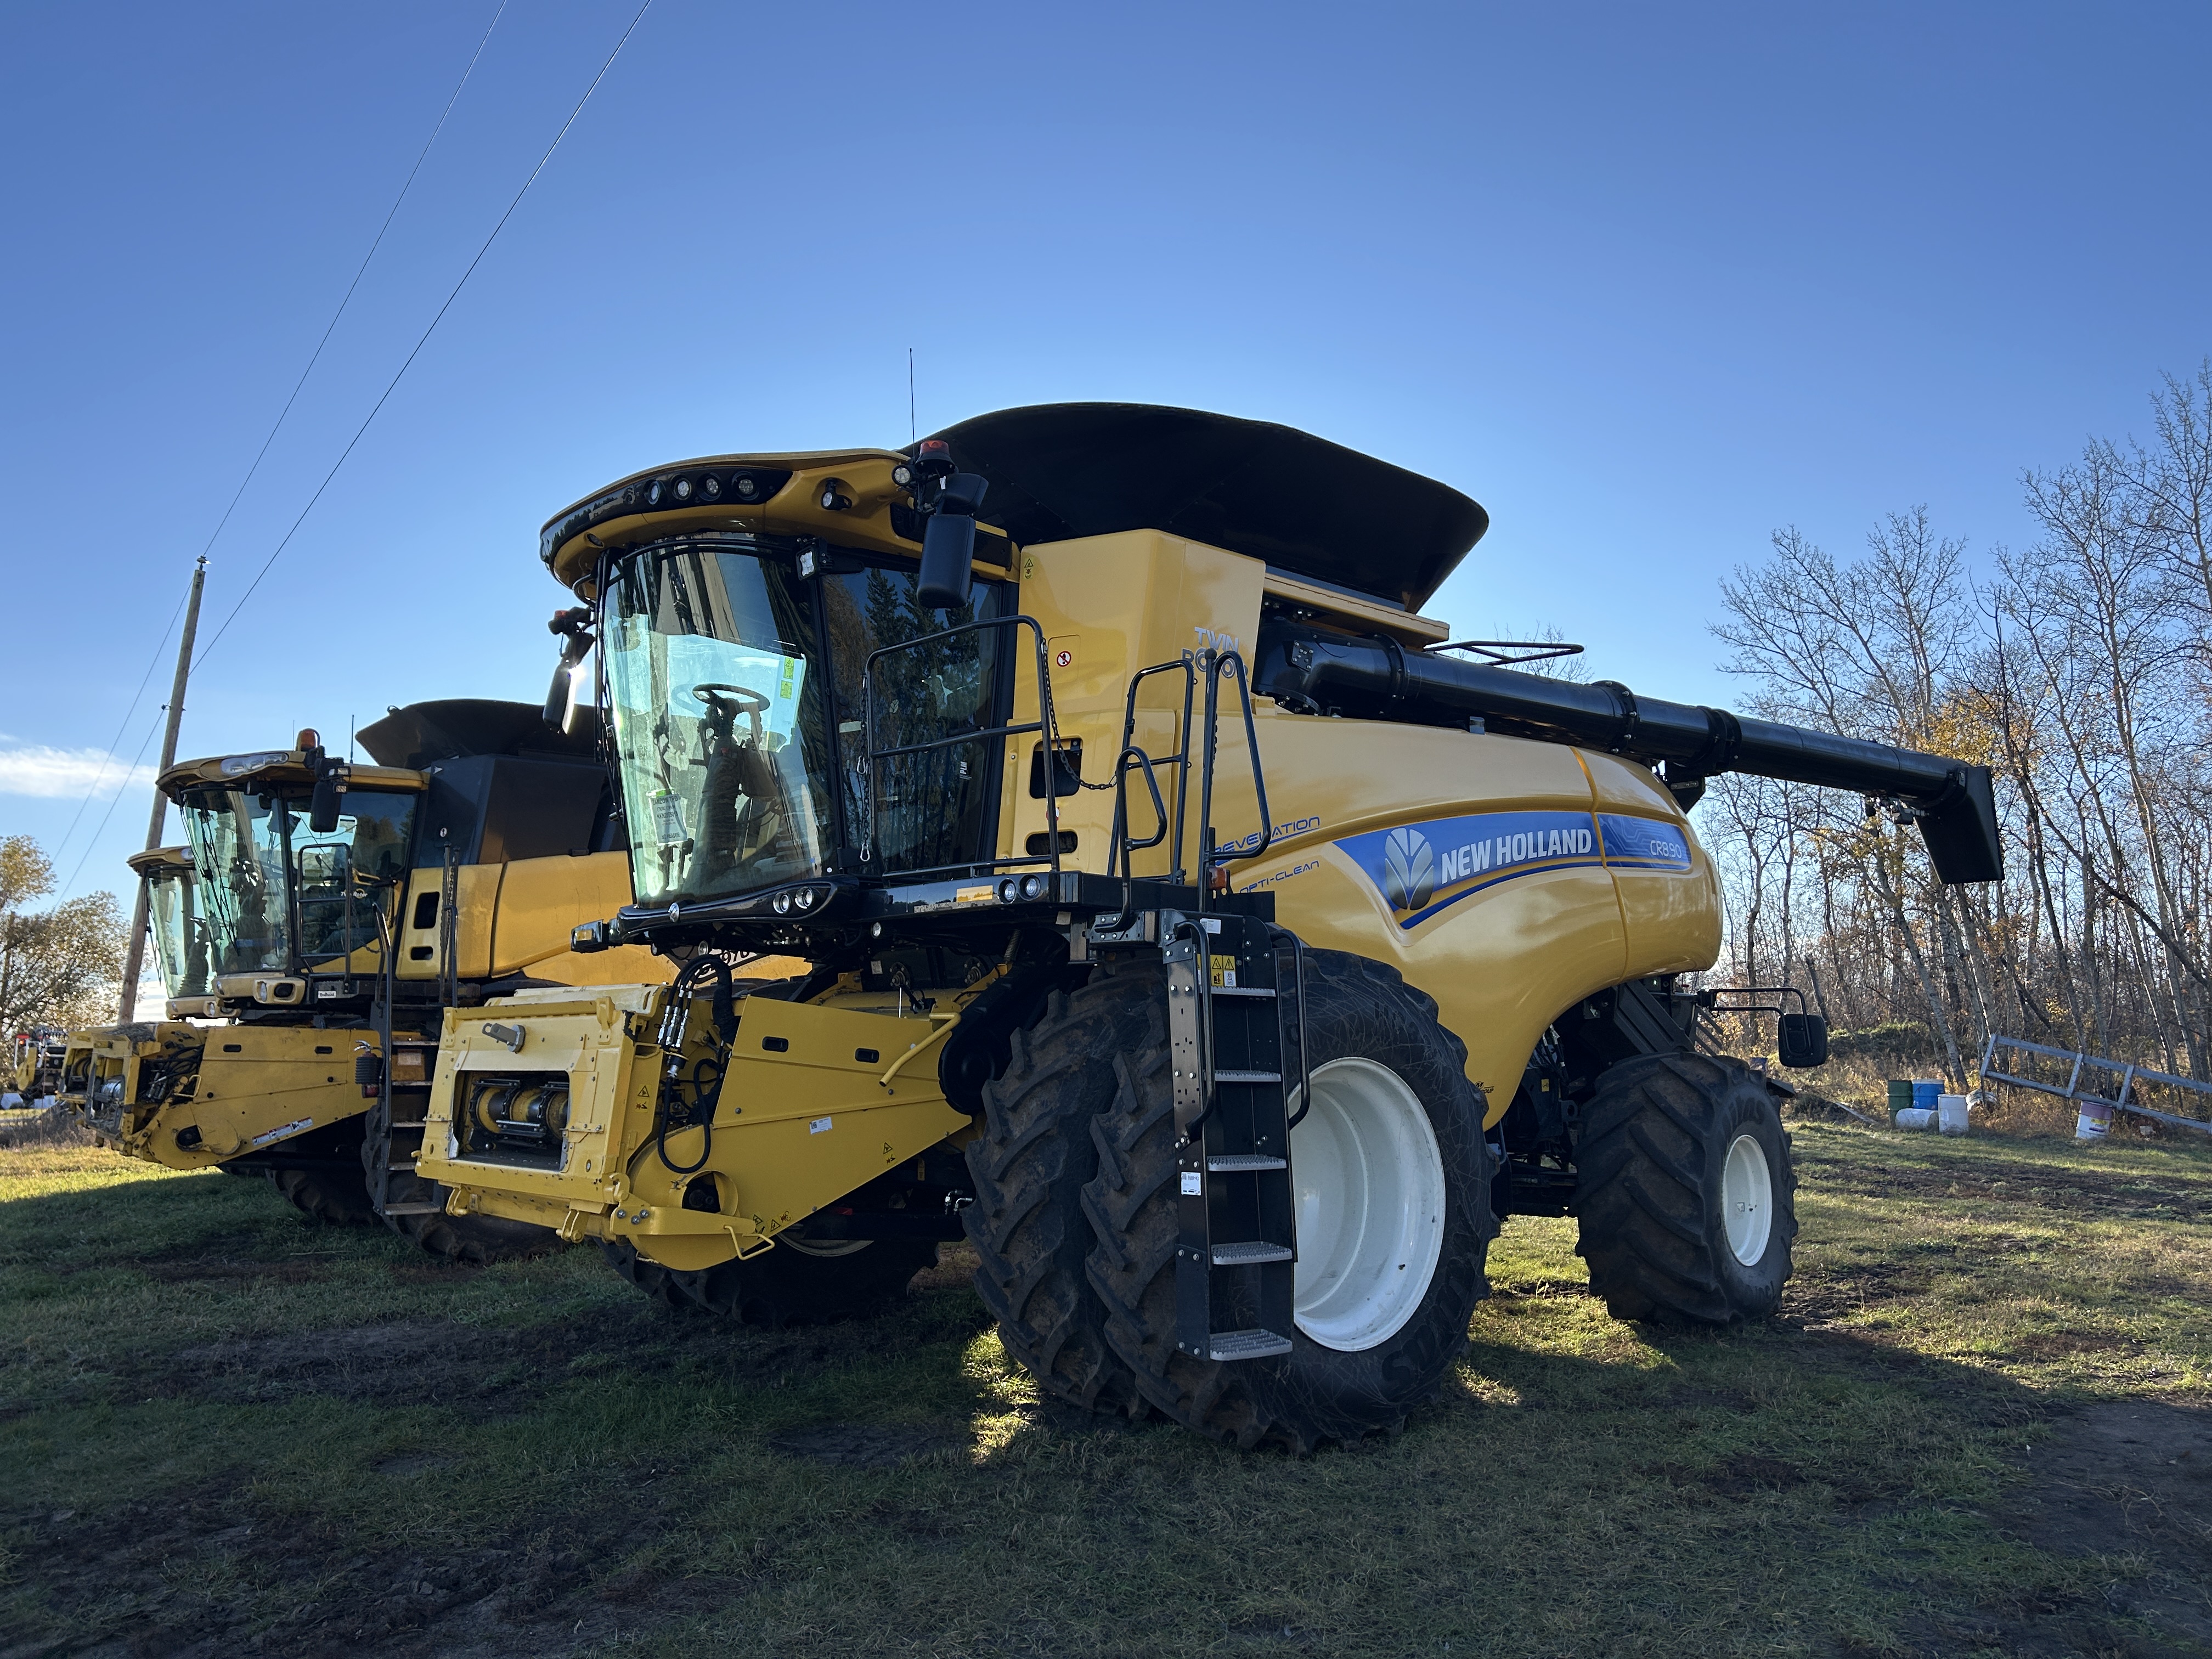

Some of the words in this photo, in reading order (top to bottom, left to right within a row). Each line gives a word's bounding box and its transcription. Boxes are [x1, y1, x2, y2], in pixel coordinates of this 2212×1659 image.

[1194, 627, 1238, 653] TWIN
[1182, 648, 1249, 682] ROO
[1441, 839, 1491, 884] NEW
[1496, 829, 1592, 866] HOLLAND
[1650, 839, 1682, 859] CR8.90
[1240, 860, 1319, 893] OPTI-CLEAN
